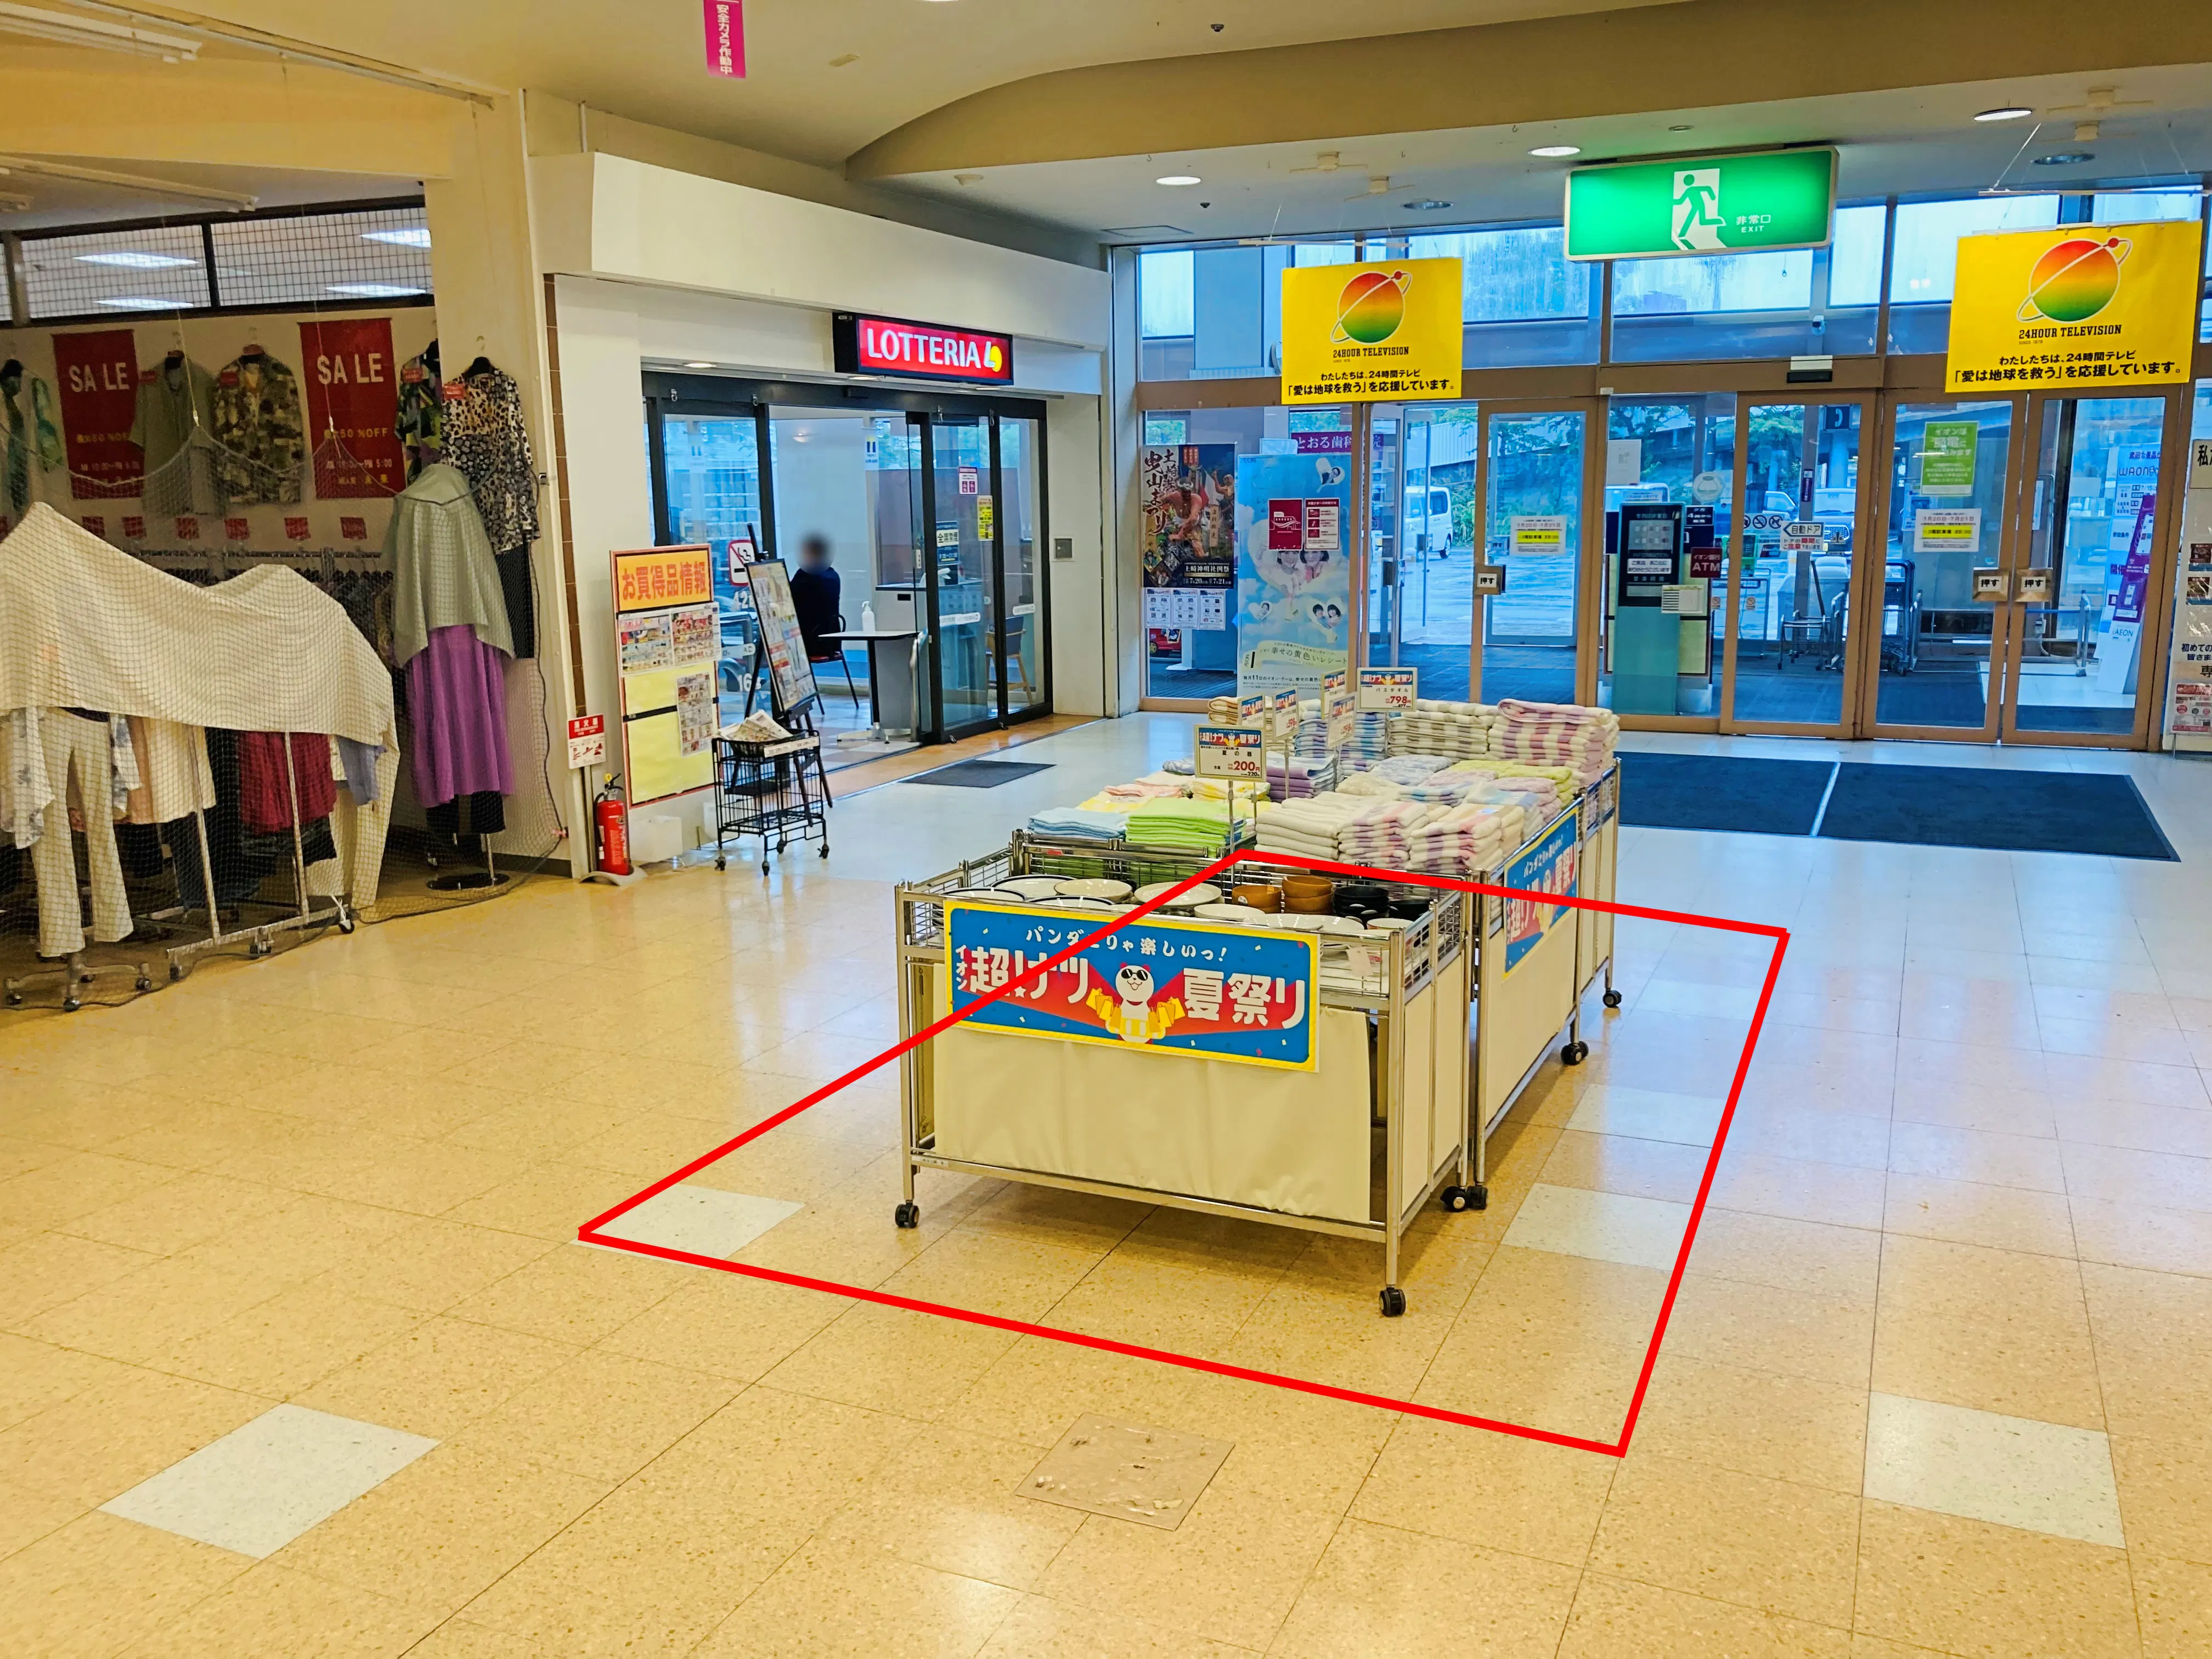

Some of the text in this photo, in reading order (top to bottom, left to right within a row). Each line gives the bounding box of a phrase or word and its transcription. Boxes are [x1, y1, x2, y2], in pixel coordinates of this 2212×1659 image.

[1736, 215, 1771, 225] 非常口
[1741, 225, 1765, 233] EXIT
[2018, 324, 2123, 339] 24HOUR TELEVISION
[867, 328, 981, 369] LOTTERIA
[1333, 346, 1409, 358] 24HOUR TELEVISION
[316, 352, 384, 385] SALE
[69, 362, 129, 393] SALE
[1297, 435, 1381, 449] とおる歯科院
[2197, 444, 2212, 467] 私
[1791, 524, 1820, 534] 自動ドア
[1692, 562, 1720, 571] ATM
[622, 561, 707, 601] お買得品情報
[2024, 579, 2044, 588] 押す
[955, 944, 968, 991] イオン
[1183, 967, 1306, 1030] 夏祭り
